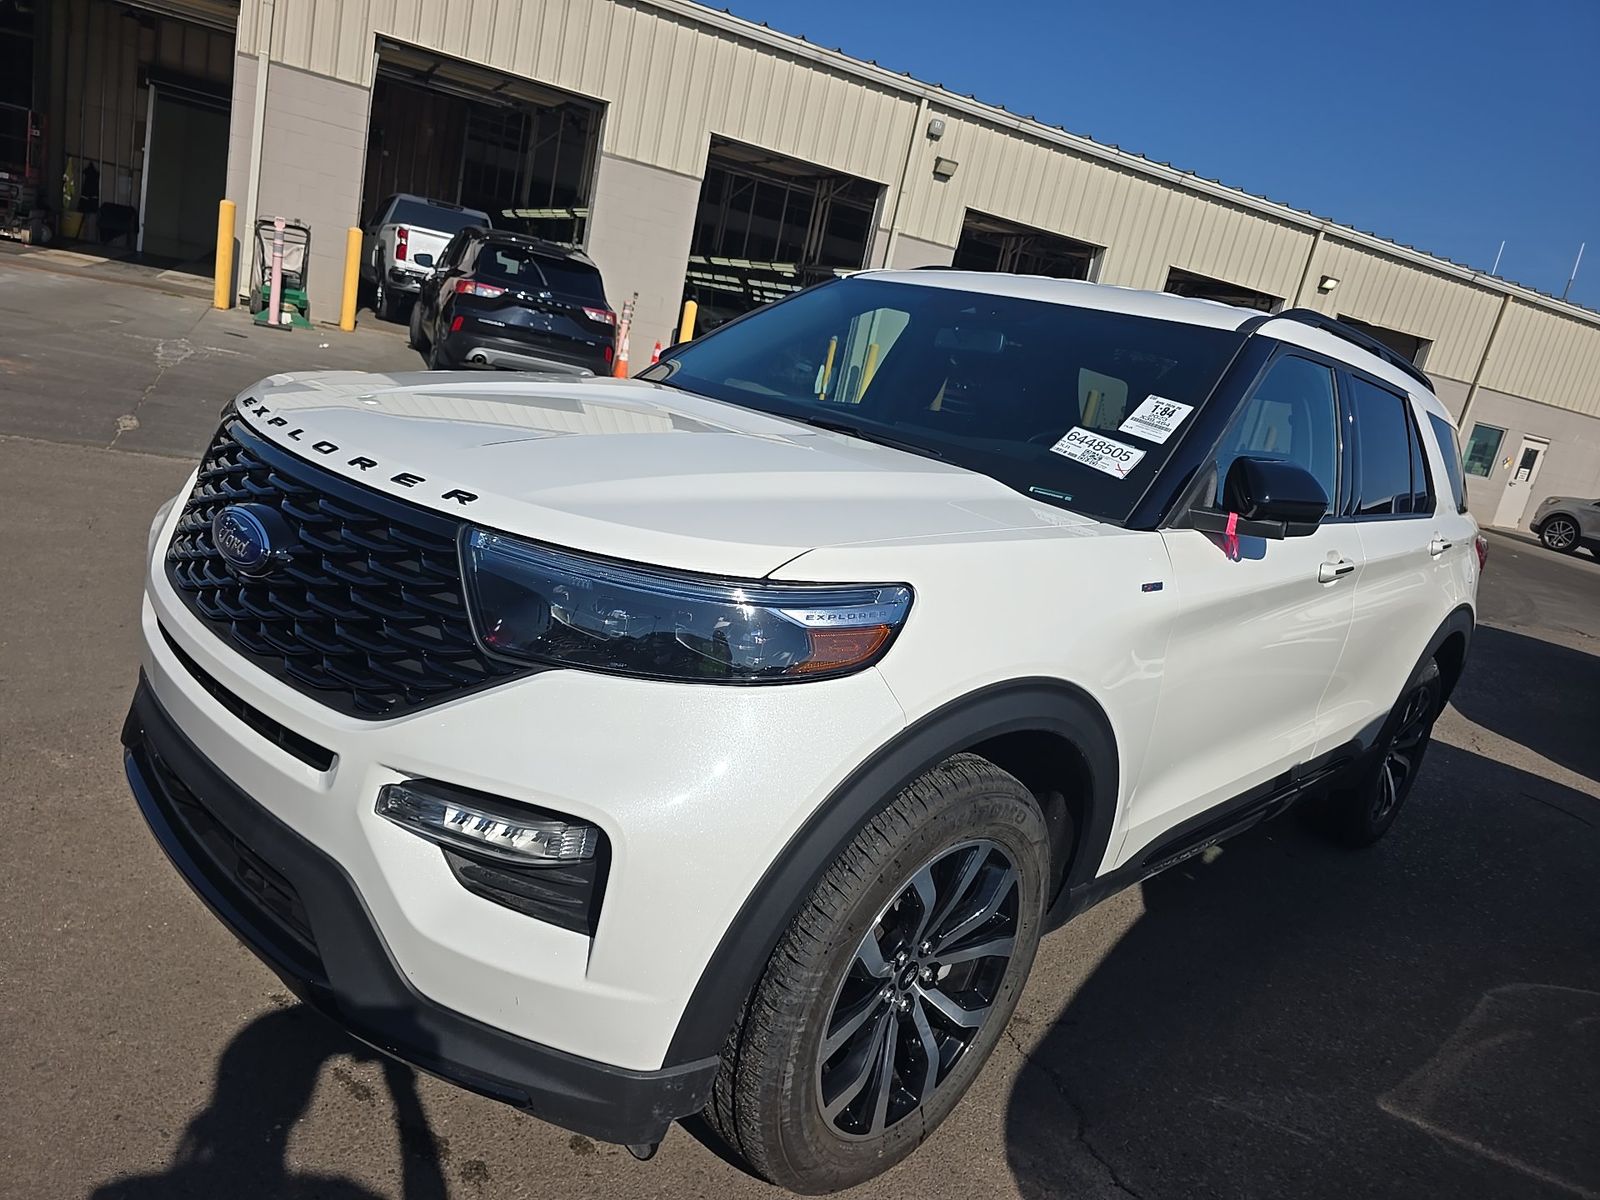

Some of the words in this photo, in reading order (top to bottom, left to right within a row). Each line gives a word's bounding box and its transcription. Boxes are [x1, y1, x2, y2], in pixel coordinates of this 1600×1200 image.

[242, 396, 479, 506] EXPLORER
[1067, 431, 1134, 462] 6448505
[218, 524, 253, 558] Ford
[805, 611, 887, 621] EXPLORER
